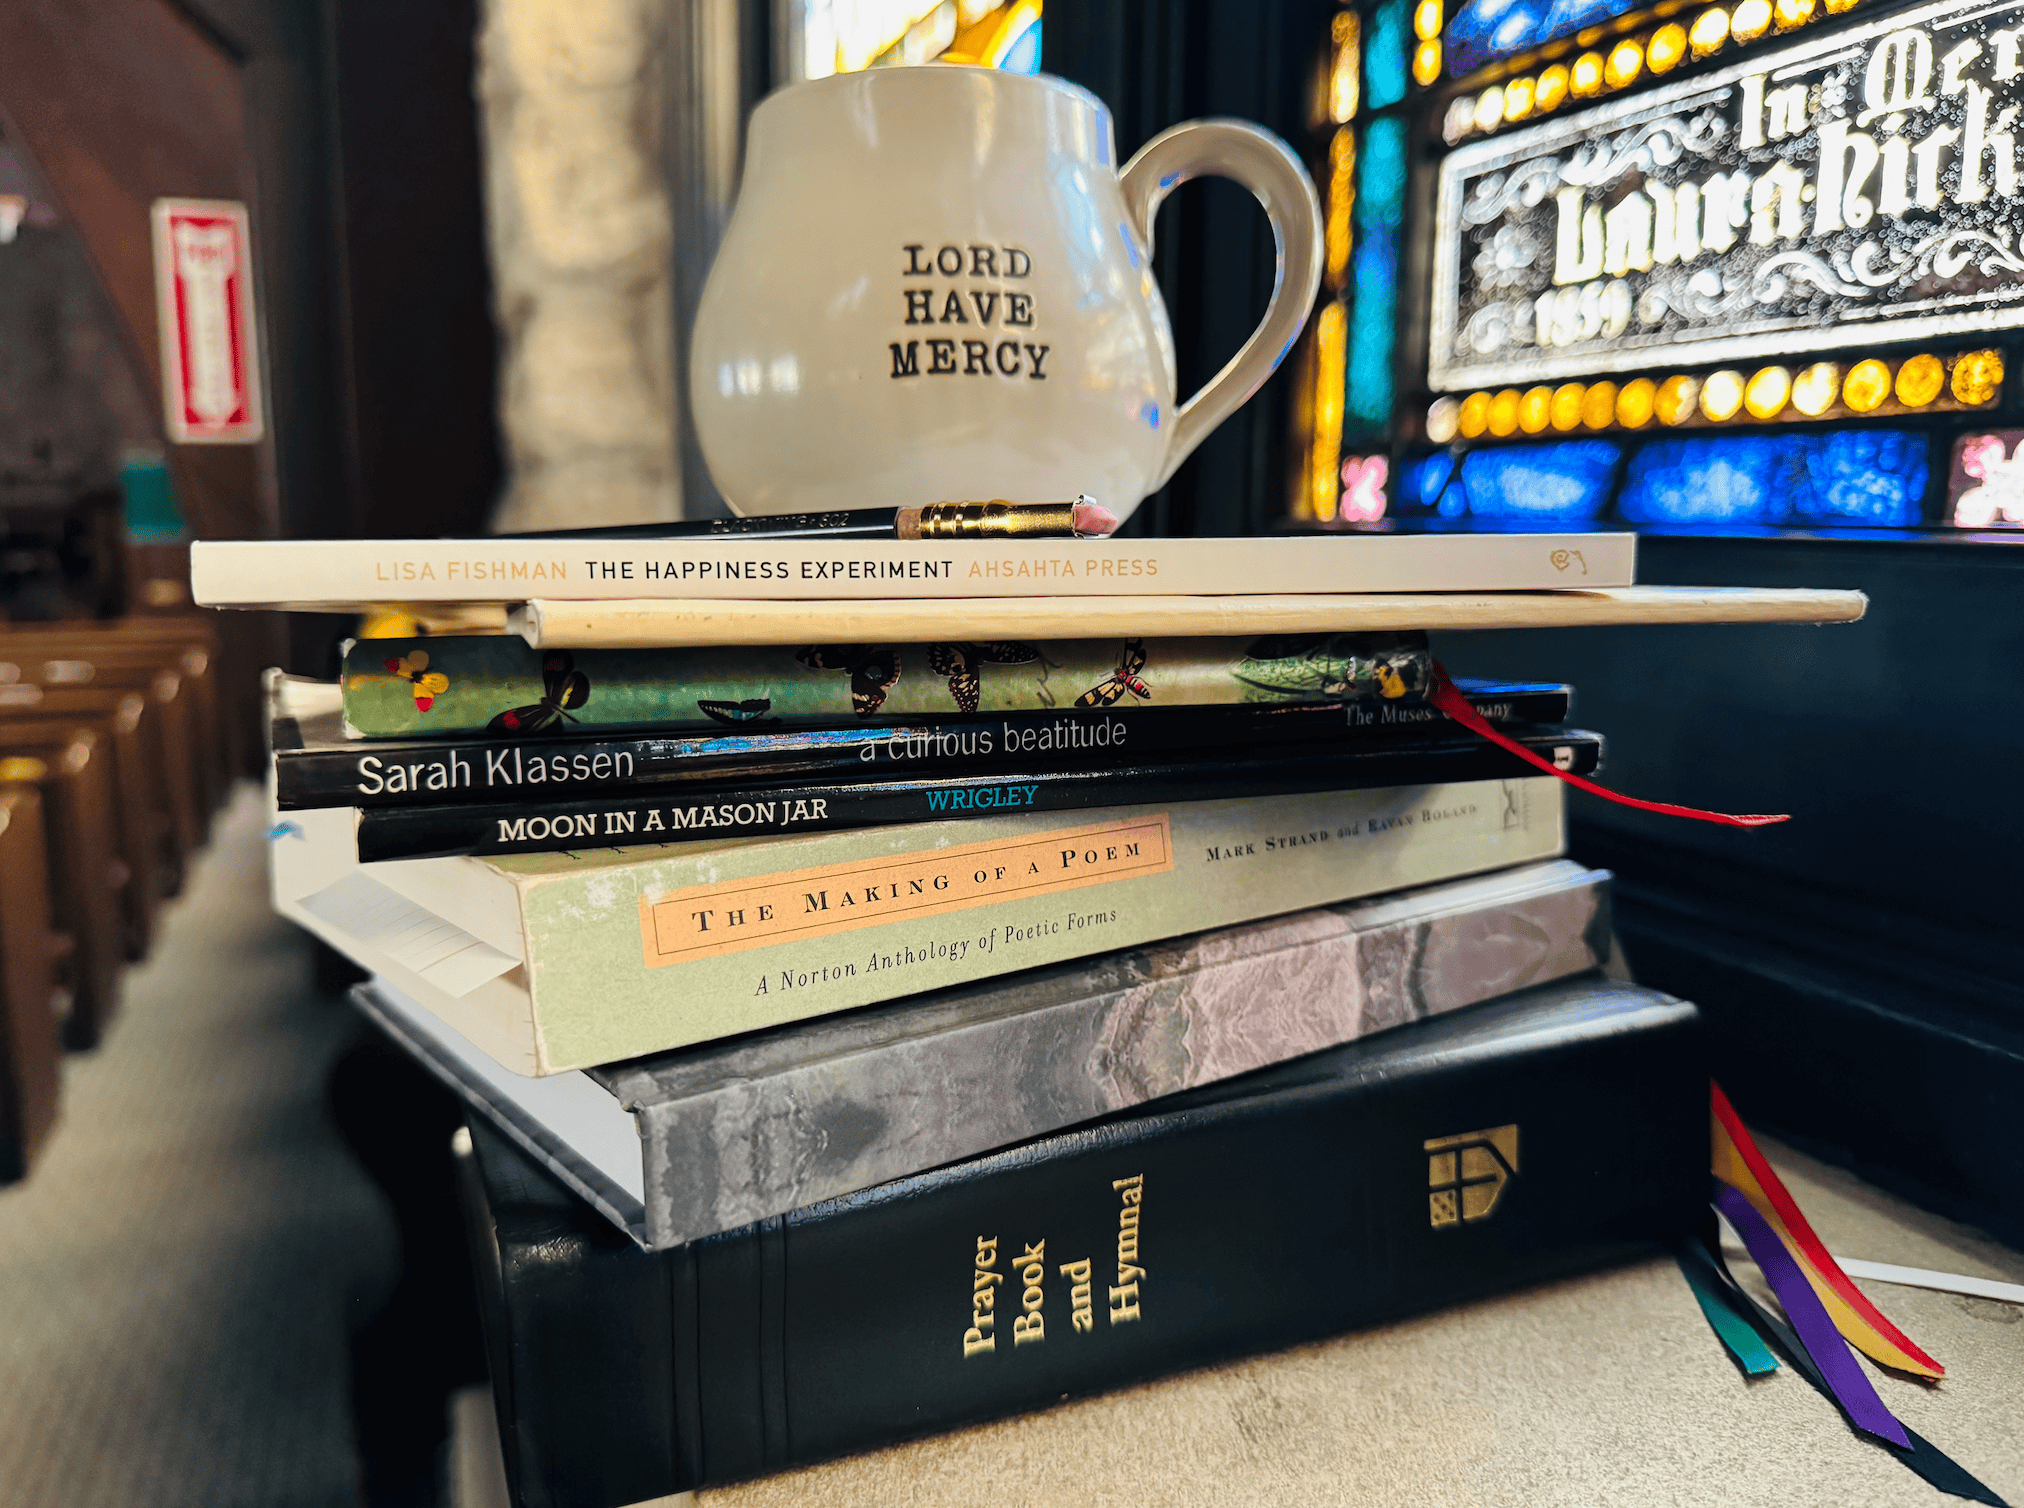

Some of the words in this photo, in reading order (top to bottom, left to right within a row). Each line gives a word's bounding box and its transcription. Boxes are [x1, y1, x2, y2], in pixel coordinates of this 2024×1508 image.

[1738, 73, 1809, 149] In
[903, 245, 1032, 278] LORD
[904, 289, 1033, 326] HAVE
[889, 339, 1050, 379] MERCY
[376, 562, 436, 581] LISA
[447, 561, 567, 580] FISHMAN
[585, 561, 634, 580] THE
[645, 560, 789, 580] HAPPINESS
[801, 560, 953, 579] EXPERIMENT
[968, 559, 1076, 578] AHSAHTA
[1085, 558, 1159, 577] PRESS
[860, 737, 876, 762] a
[888, 726, 993, 761] curious
[1003, 716, 1127, 752] beatitude
[1344, 705, 1374, 726] The
[1381, 704, 1432, 723] Muses
[358, 750, 471, 795] Sarah
[486, 747, 634, 787] Klassen
[498, 813, 597, 842] MOON
[604, 811, 636, 835] IN
[642, 809, 666, 832] A
[672, 803, 775, 830] MASON
[780, 798, 828, 826] JAR
[926, 785, 1039, 811] WRIGLEY
[1206, 843, 1255, 862] MARK
[1265, 829, 1329, 852] STRAND
[692, 904, 774, 933] THE
[803, 874, 950, 913] MAKING
[1027, 861, 1040, 875] A
[1061, 841, 1141, 868] POEM
[754, 975, 769, 997] A
[780, 961, 857, 991] Norton
[866, 936, 970, 973] Anthology
[978, 929, 997, 953] of
[1005, 919, 1059, 945] Poetic
[1067, 907, 1118, 931] Forms
[1108, 1173, 1147, 1326] Hymnal
[963, 1235, 1004, 1359] Prayer
[1012, 1238, 1045, 1348] Book
[1059, 1257, 1094, 1334] and
